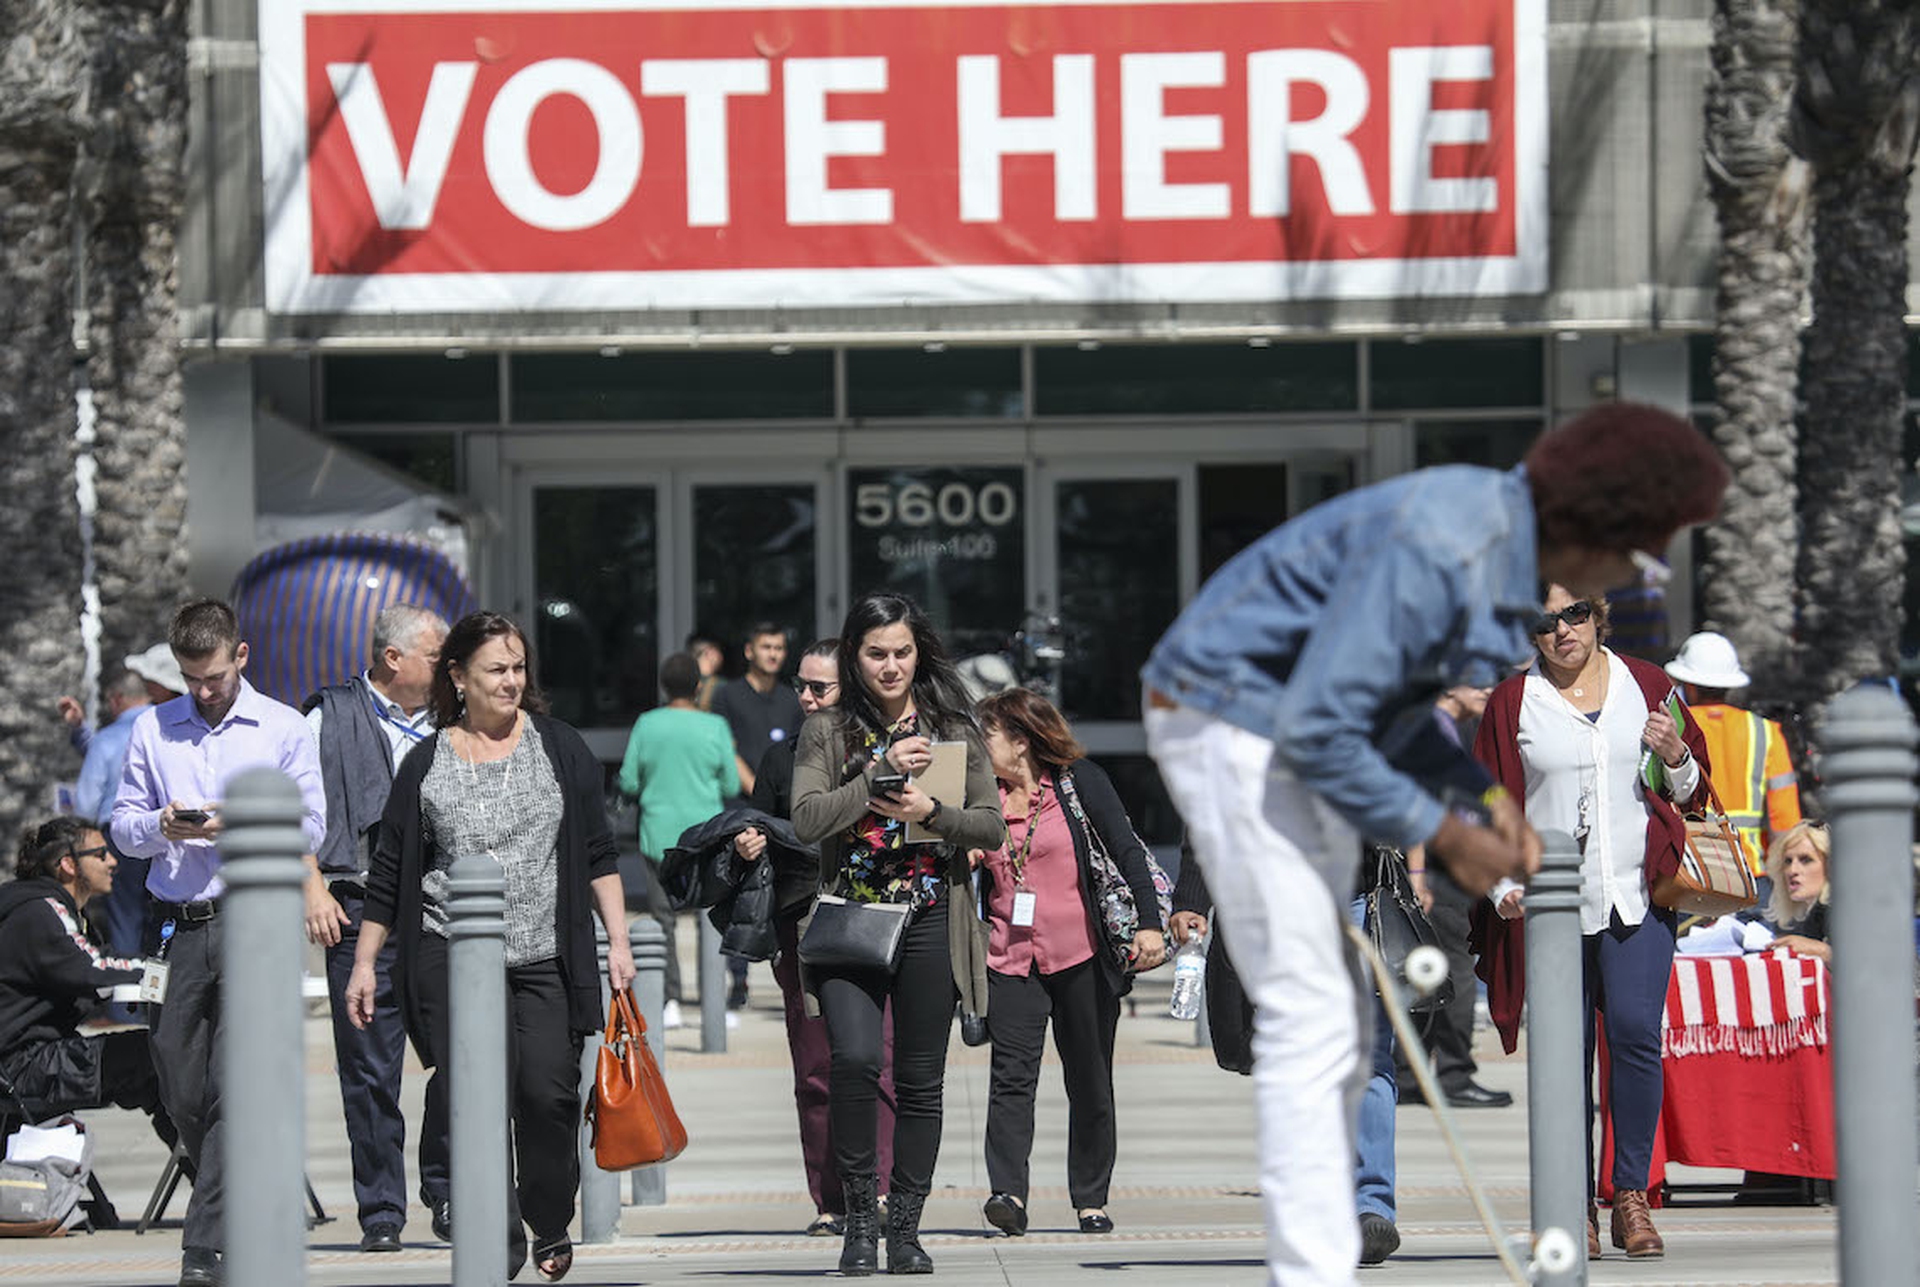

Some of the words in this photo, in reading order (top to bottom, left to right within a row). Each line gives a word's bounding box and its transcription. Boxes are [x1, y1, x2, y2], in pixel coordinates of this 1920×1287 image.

[324, 55, 895, 232] VOTE
[956, 45, 1499, 222] HERE
[856, 482, 1015, 527] 5600
[877, 534, 938, 561] Suite
[946, 532, 997, 560] 100
